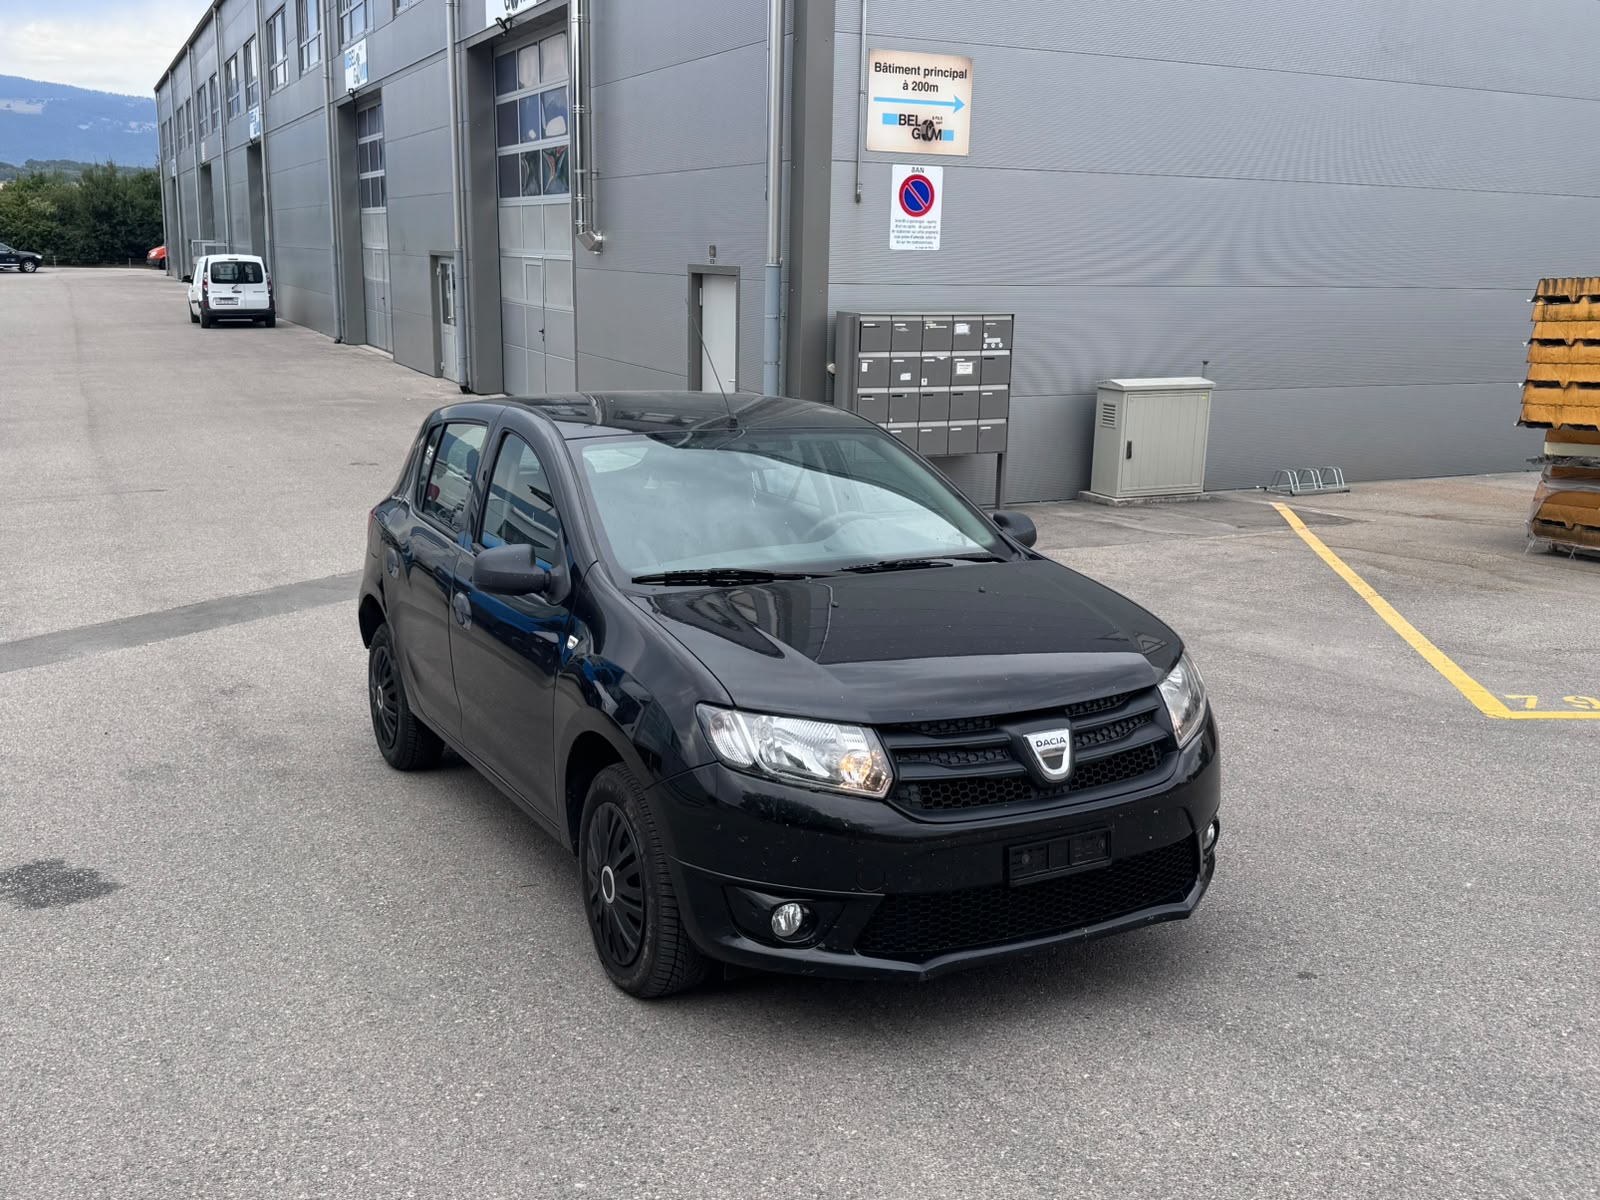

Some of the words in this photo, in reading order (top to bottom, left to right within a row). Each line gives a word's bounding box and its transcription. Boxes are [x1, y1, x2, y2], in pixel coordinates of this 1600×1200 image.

[874, 62, 921, 75] Bâtiment
[923, 66, 968, 80] principal
[902, 80, 909, 90] à
[911, 81, 939, 92] 200m
[1035, 736, 1067, 747] DACIA
